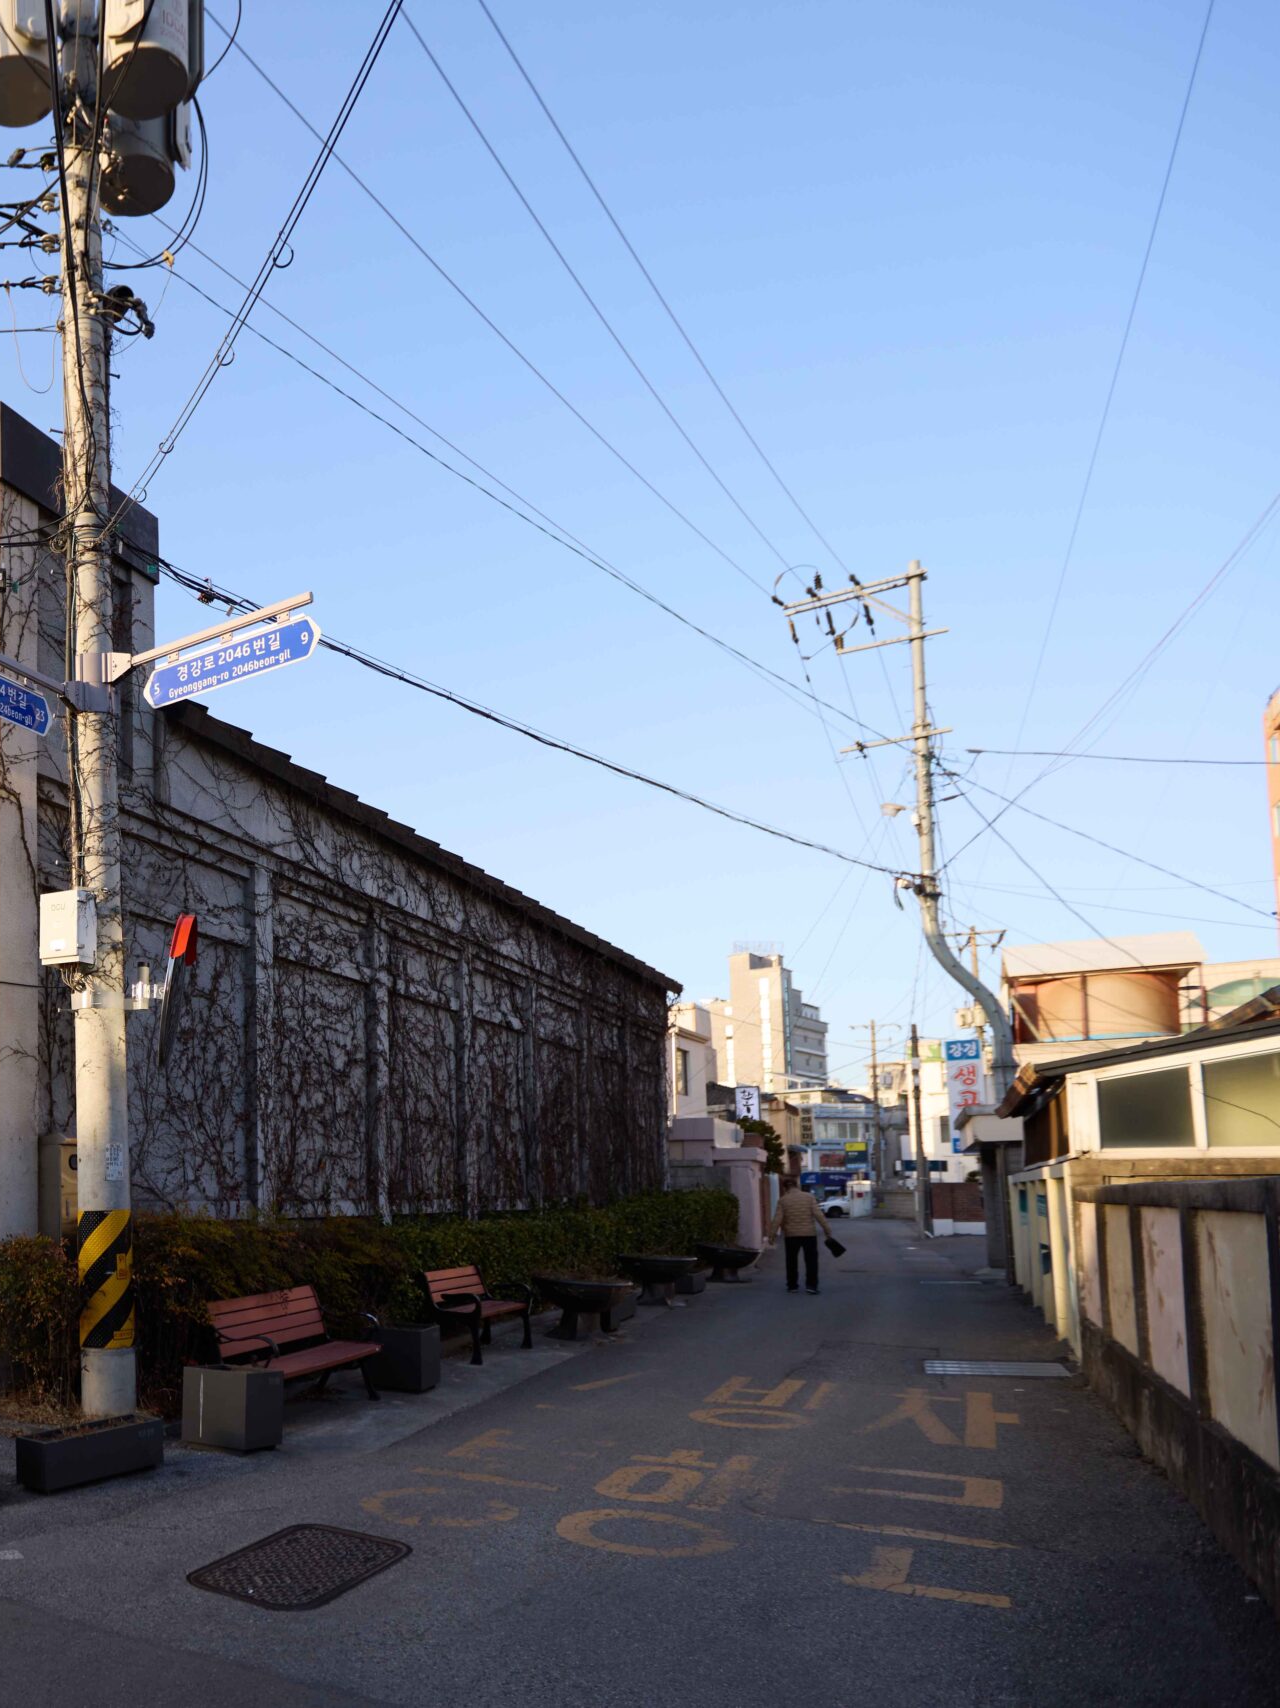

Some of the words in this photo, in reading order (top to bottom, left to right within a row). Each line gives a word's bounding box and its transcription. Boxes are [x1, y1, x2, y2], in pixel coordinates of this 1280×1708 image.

[300, 631, 309, 645] 9
[168, 670, 229, 699] Gyeonggang-ro
[232, 648, 291, 677] 2046beon-gil
[153, 682, 161, 696] 5
[35, 707, 45, 722] 23
